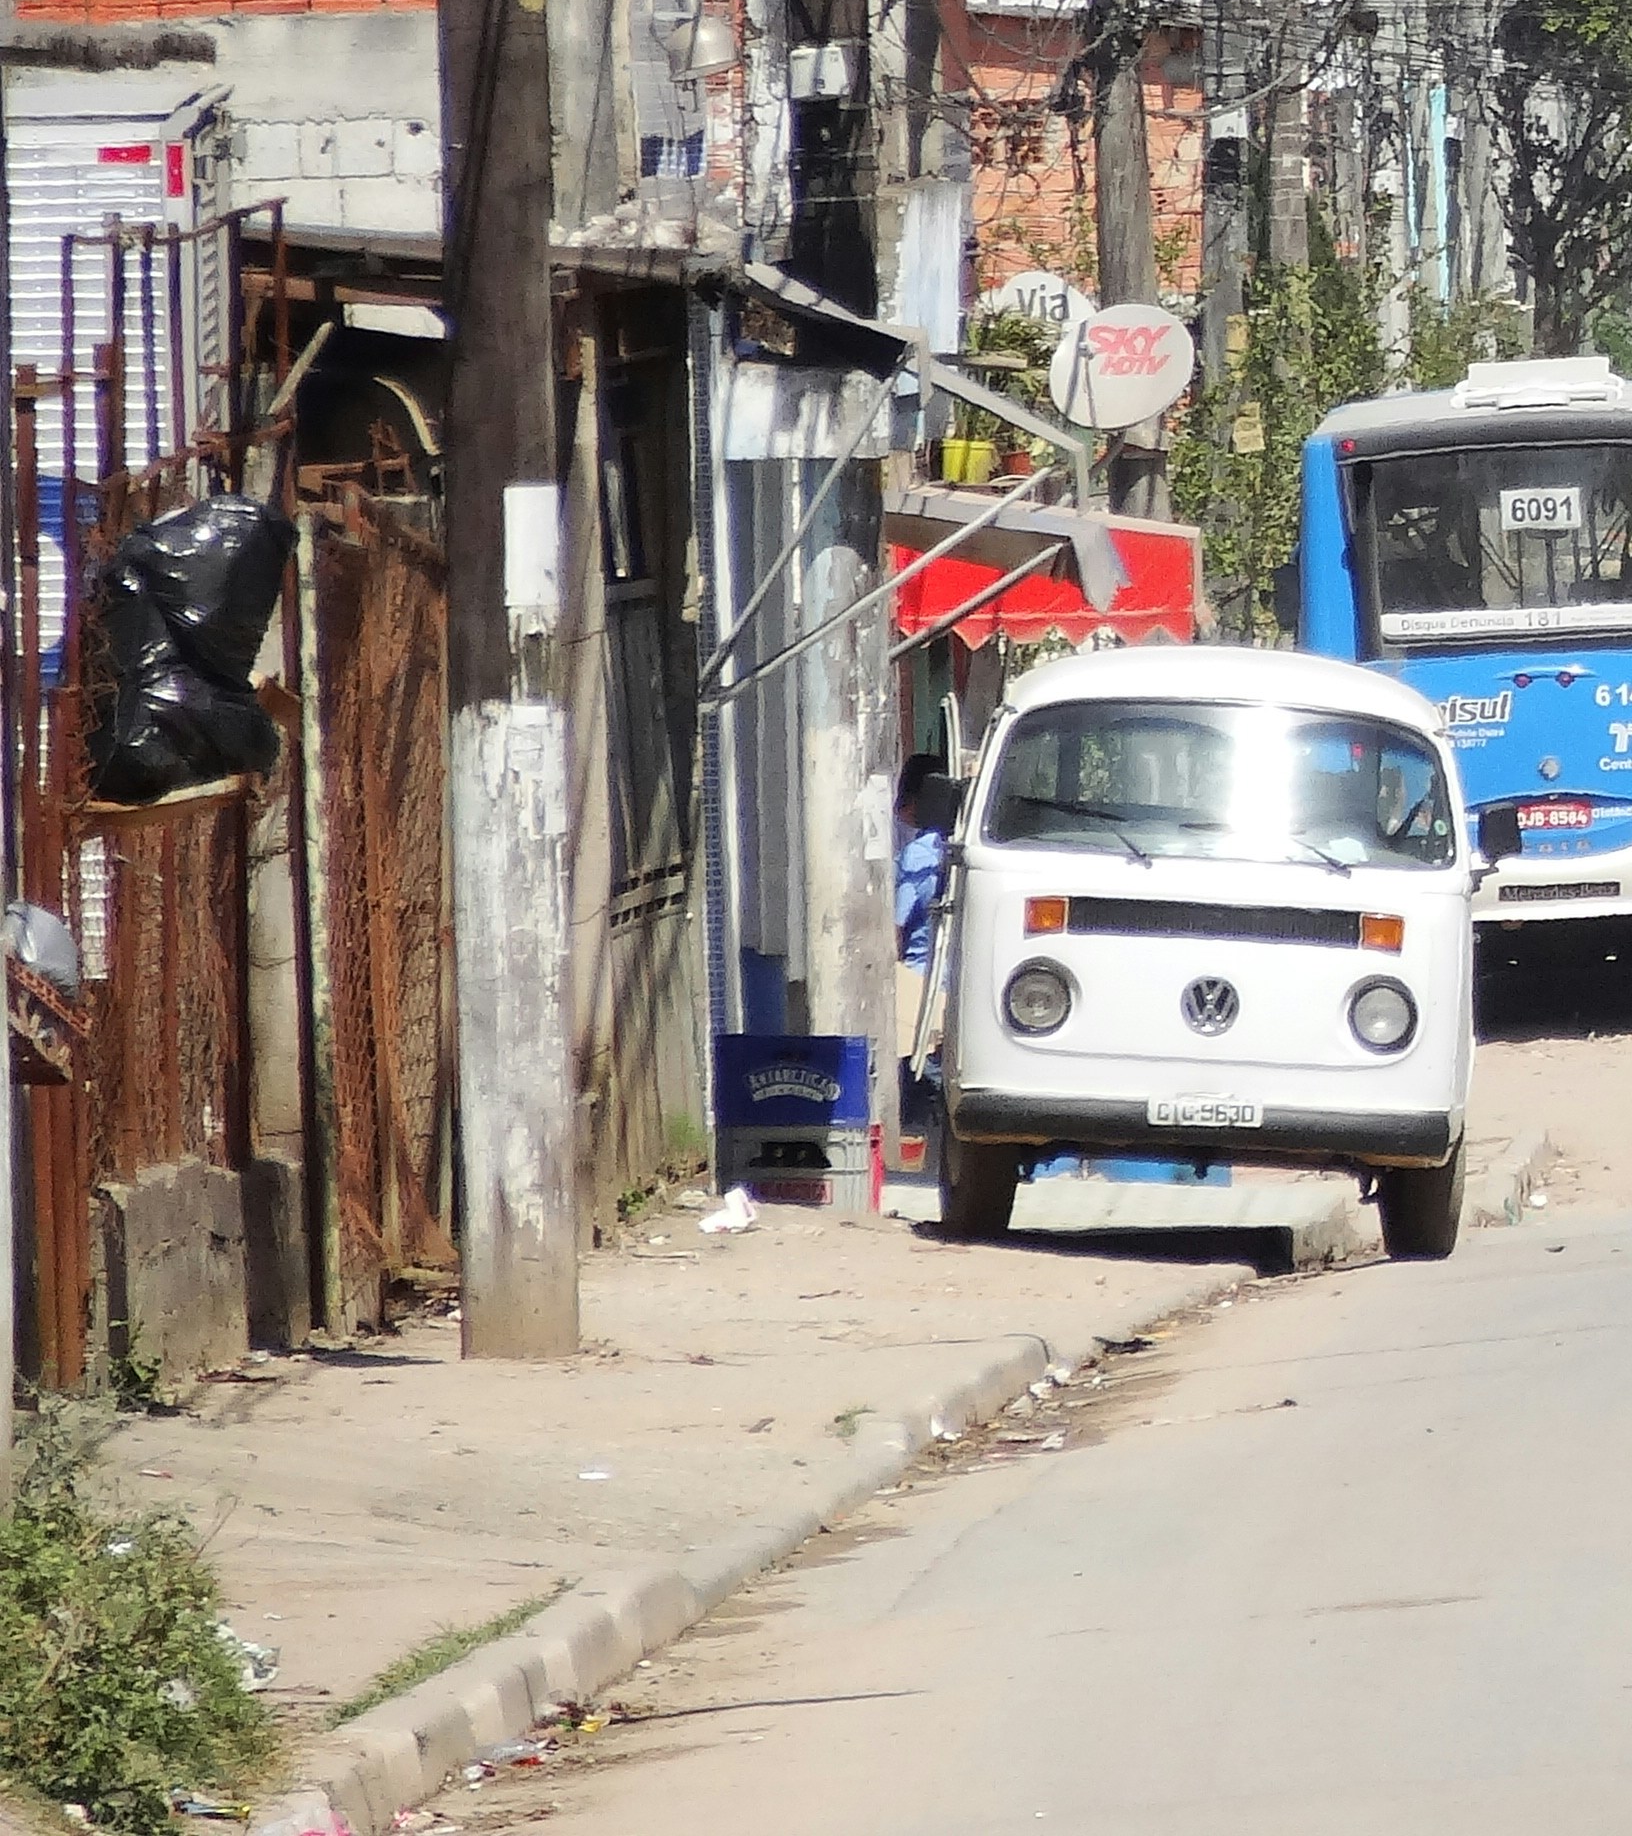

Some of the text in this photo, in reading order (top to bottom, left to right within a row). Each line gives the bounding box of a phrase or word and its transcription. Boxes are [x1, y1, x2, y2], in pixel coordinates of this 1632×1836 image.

[1015, 283, 1070, 322] Via
[1088, 324, 1172, 355] SKY
[1511, 496, 1572, 522] 6091
[1524, 611, 1561, 627] 181
[1595, 684, 1611, 707] 6
